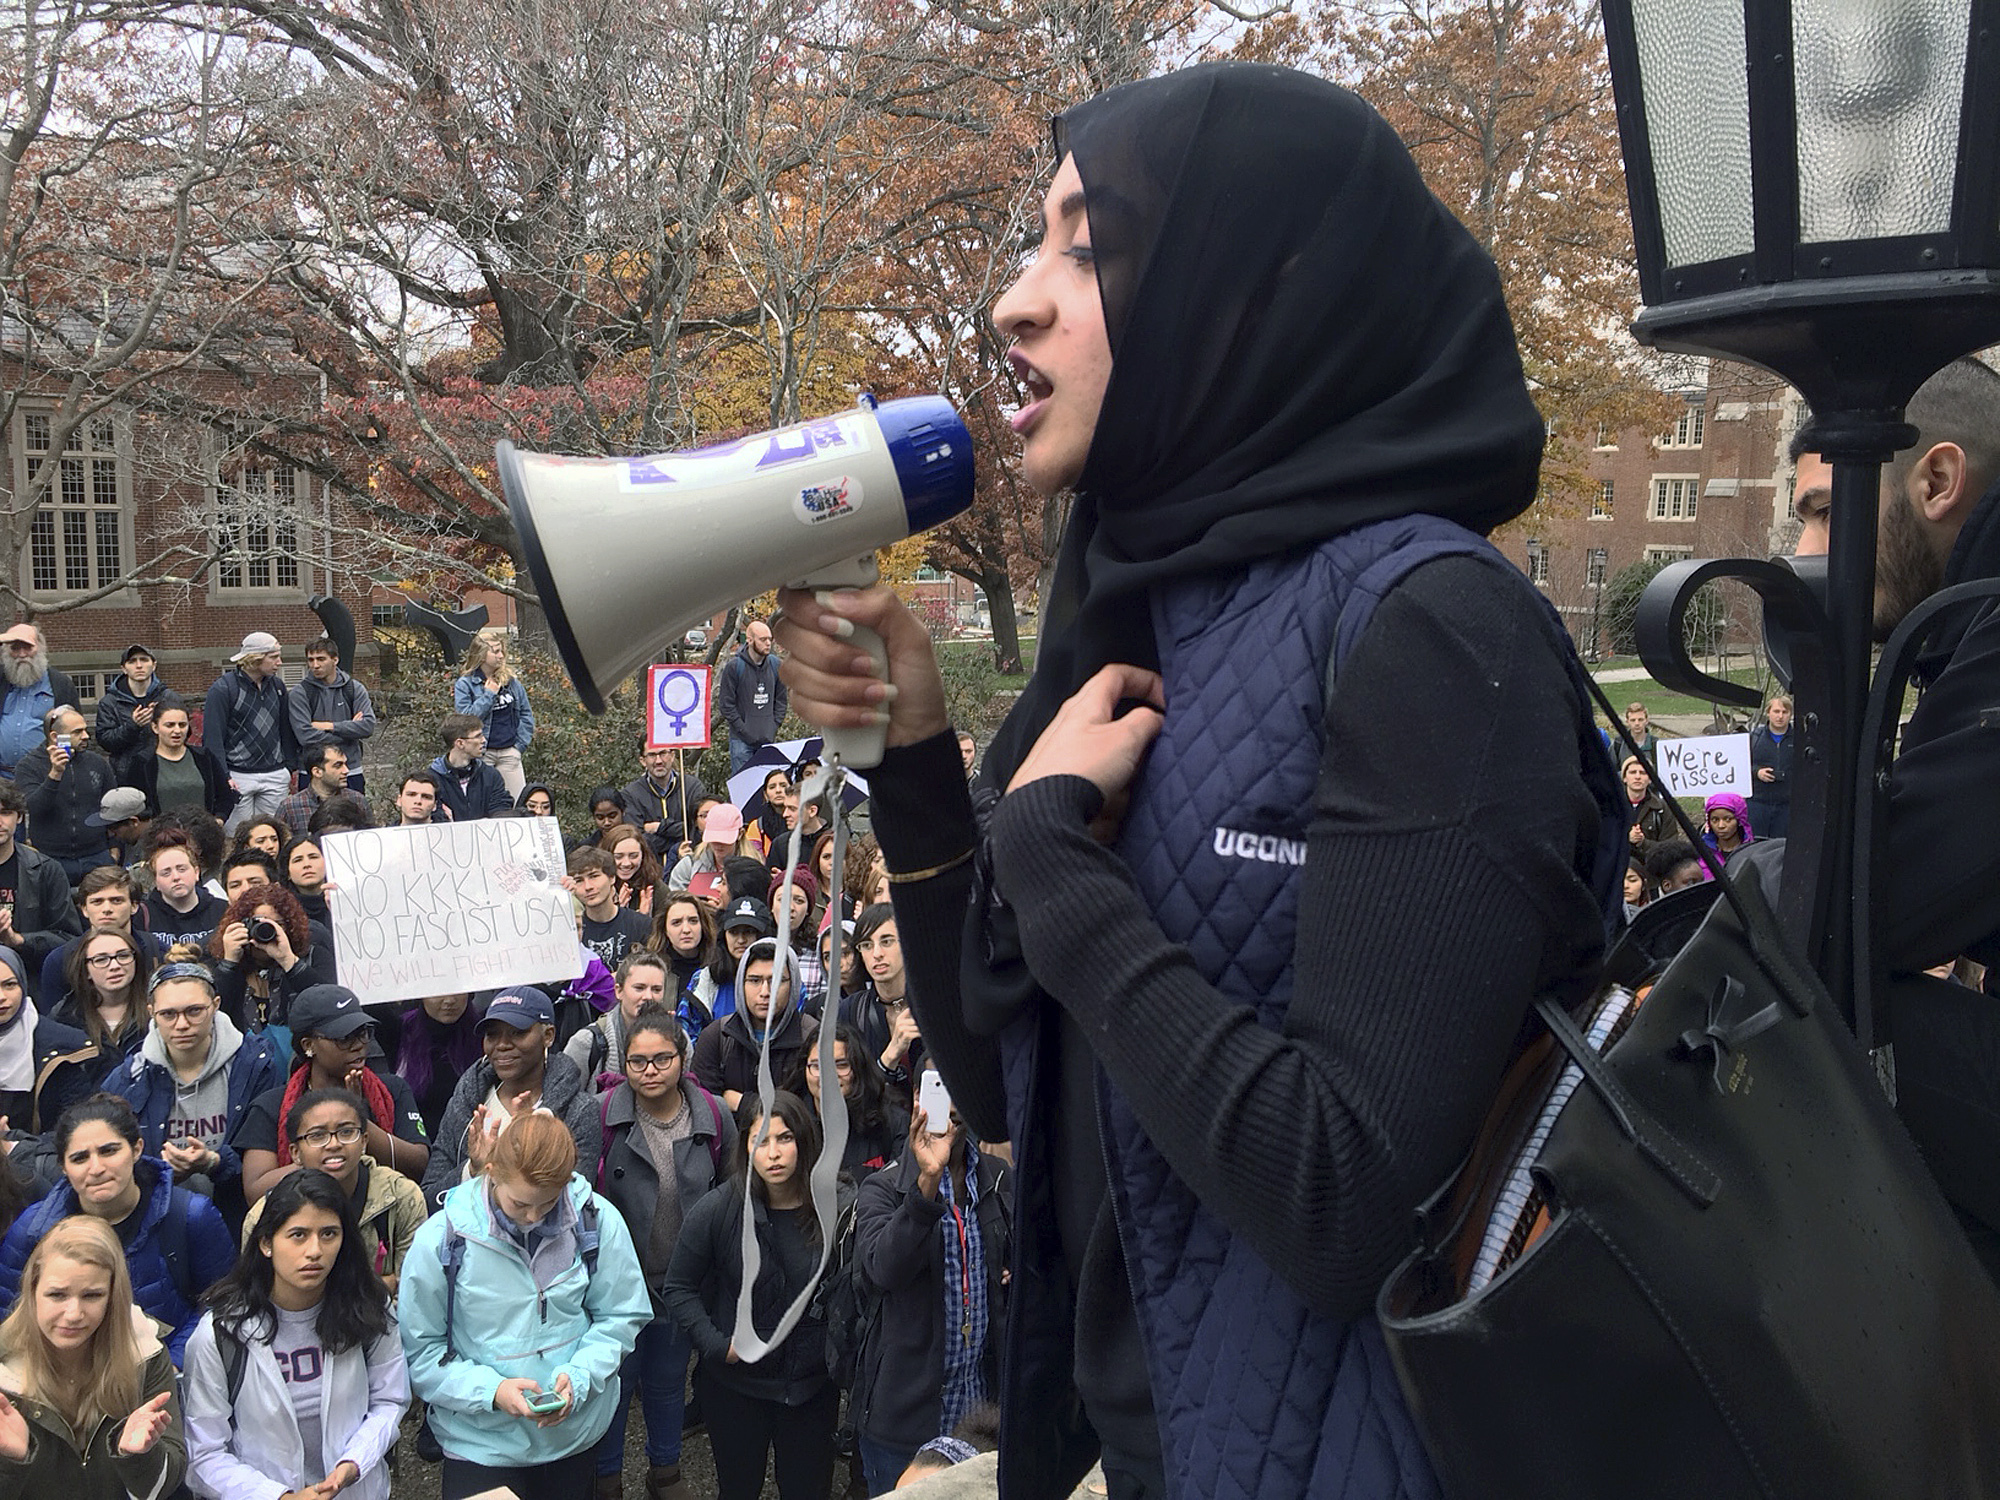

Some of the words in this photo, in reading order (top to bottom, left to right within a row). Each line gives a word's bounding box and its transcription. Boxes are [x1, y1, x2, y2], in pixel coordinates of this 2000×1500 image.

[324, 831, 383, 879] NO
[394, 820, 538, 872] TRUMP!
[336, 875, 388, 920] NO
[402, 868, 491, 915] KKK!
[335, 917, 386, 962] NO
[395, 904, 501, 955] FASCIST
[511, 896, 577, 937] USA!
[390, 958, 447, 985] WILL
[453, 949, 517, 979] FIGHT
[168, 1114, 228, 1139] CONN
